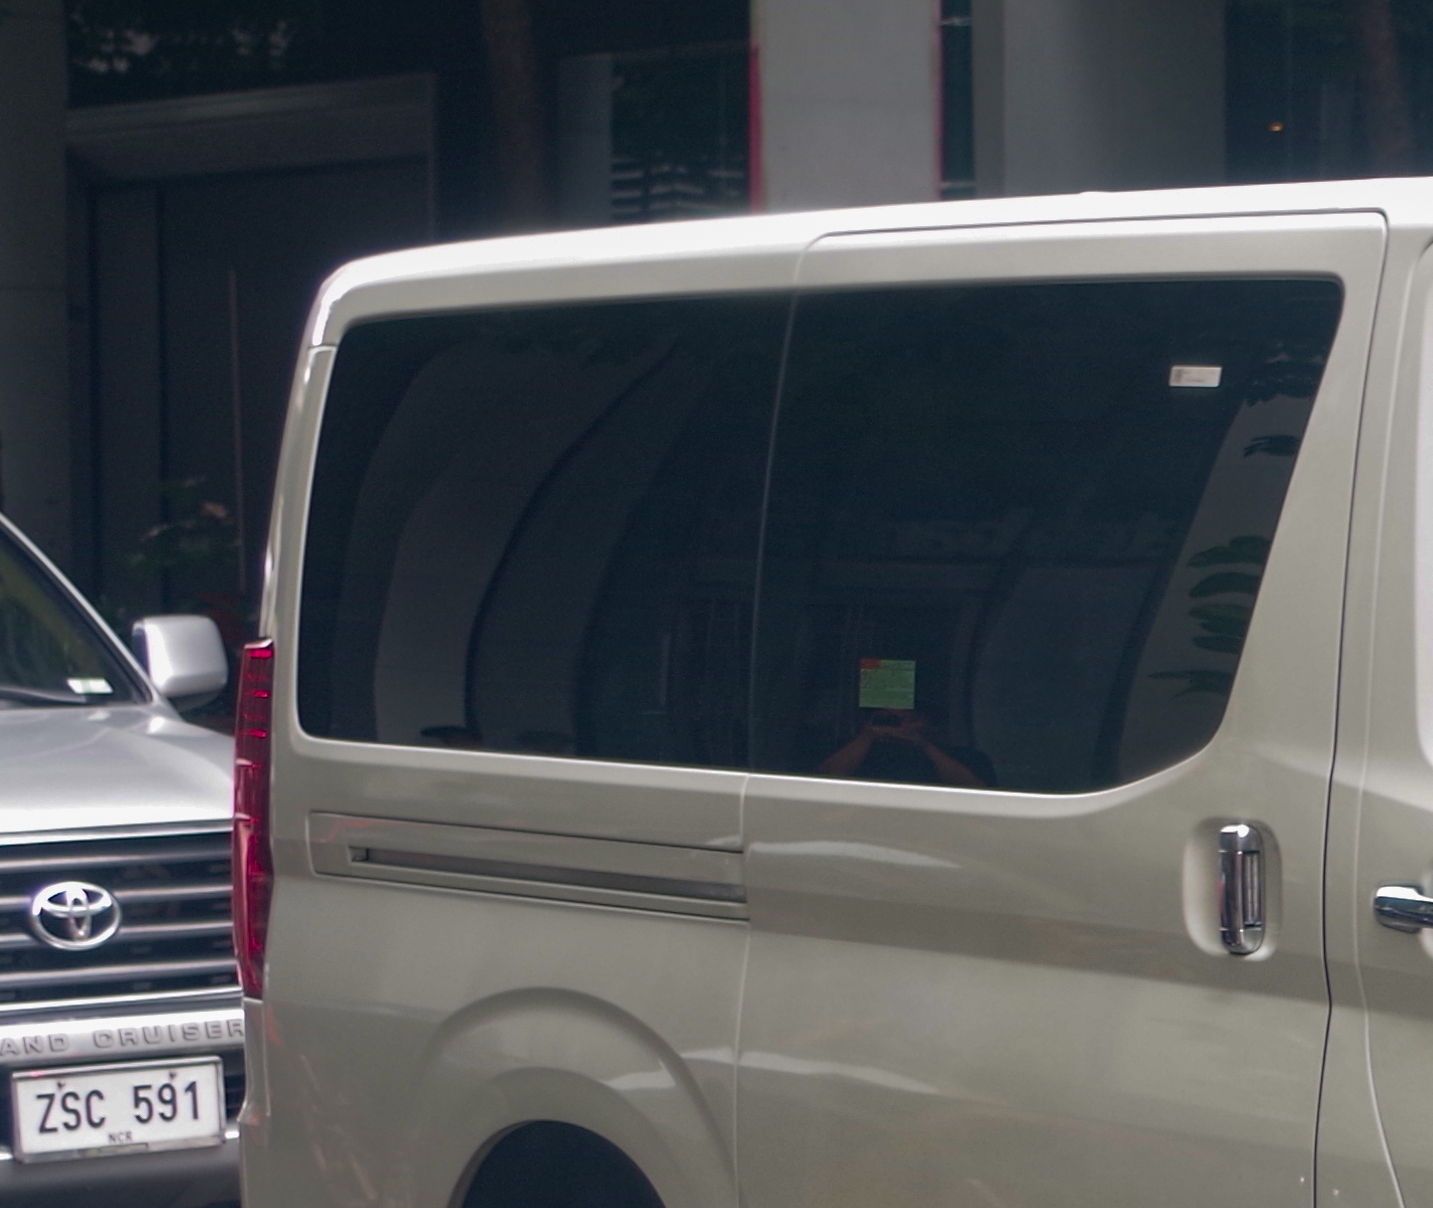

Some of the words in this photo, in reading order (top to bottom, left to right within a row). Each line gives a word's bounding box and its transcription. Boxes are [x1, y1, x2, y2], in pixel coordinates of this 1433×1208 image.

[0, 1032, 69, 1056] AND
[93, 1018, 243, 1049] CRUISER
[36, 1089, 106, 1134] ZSC
[132, 1080, 199, 1124] 591
[108, 1131, 133, 1144] NCR
